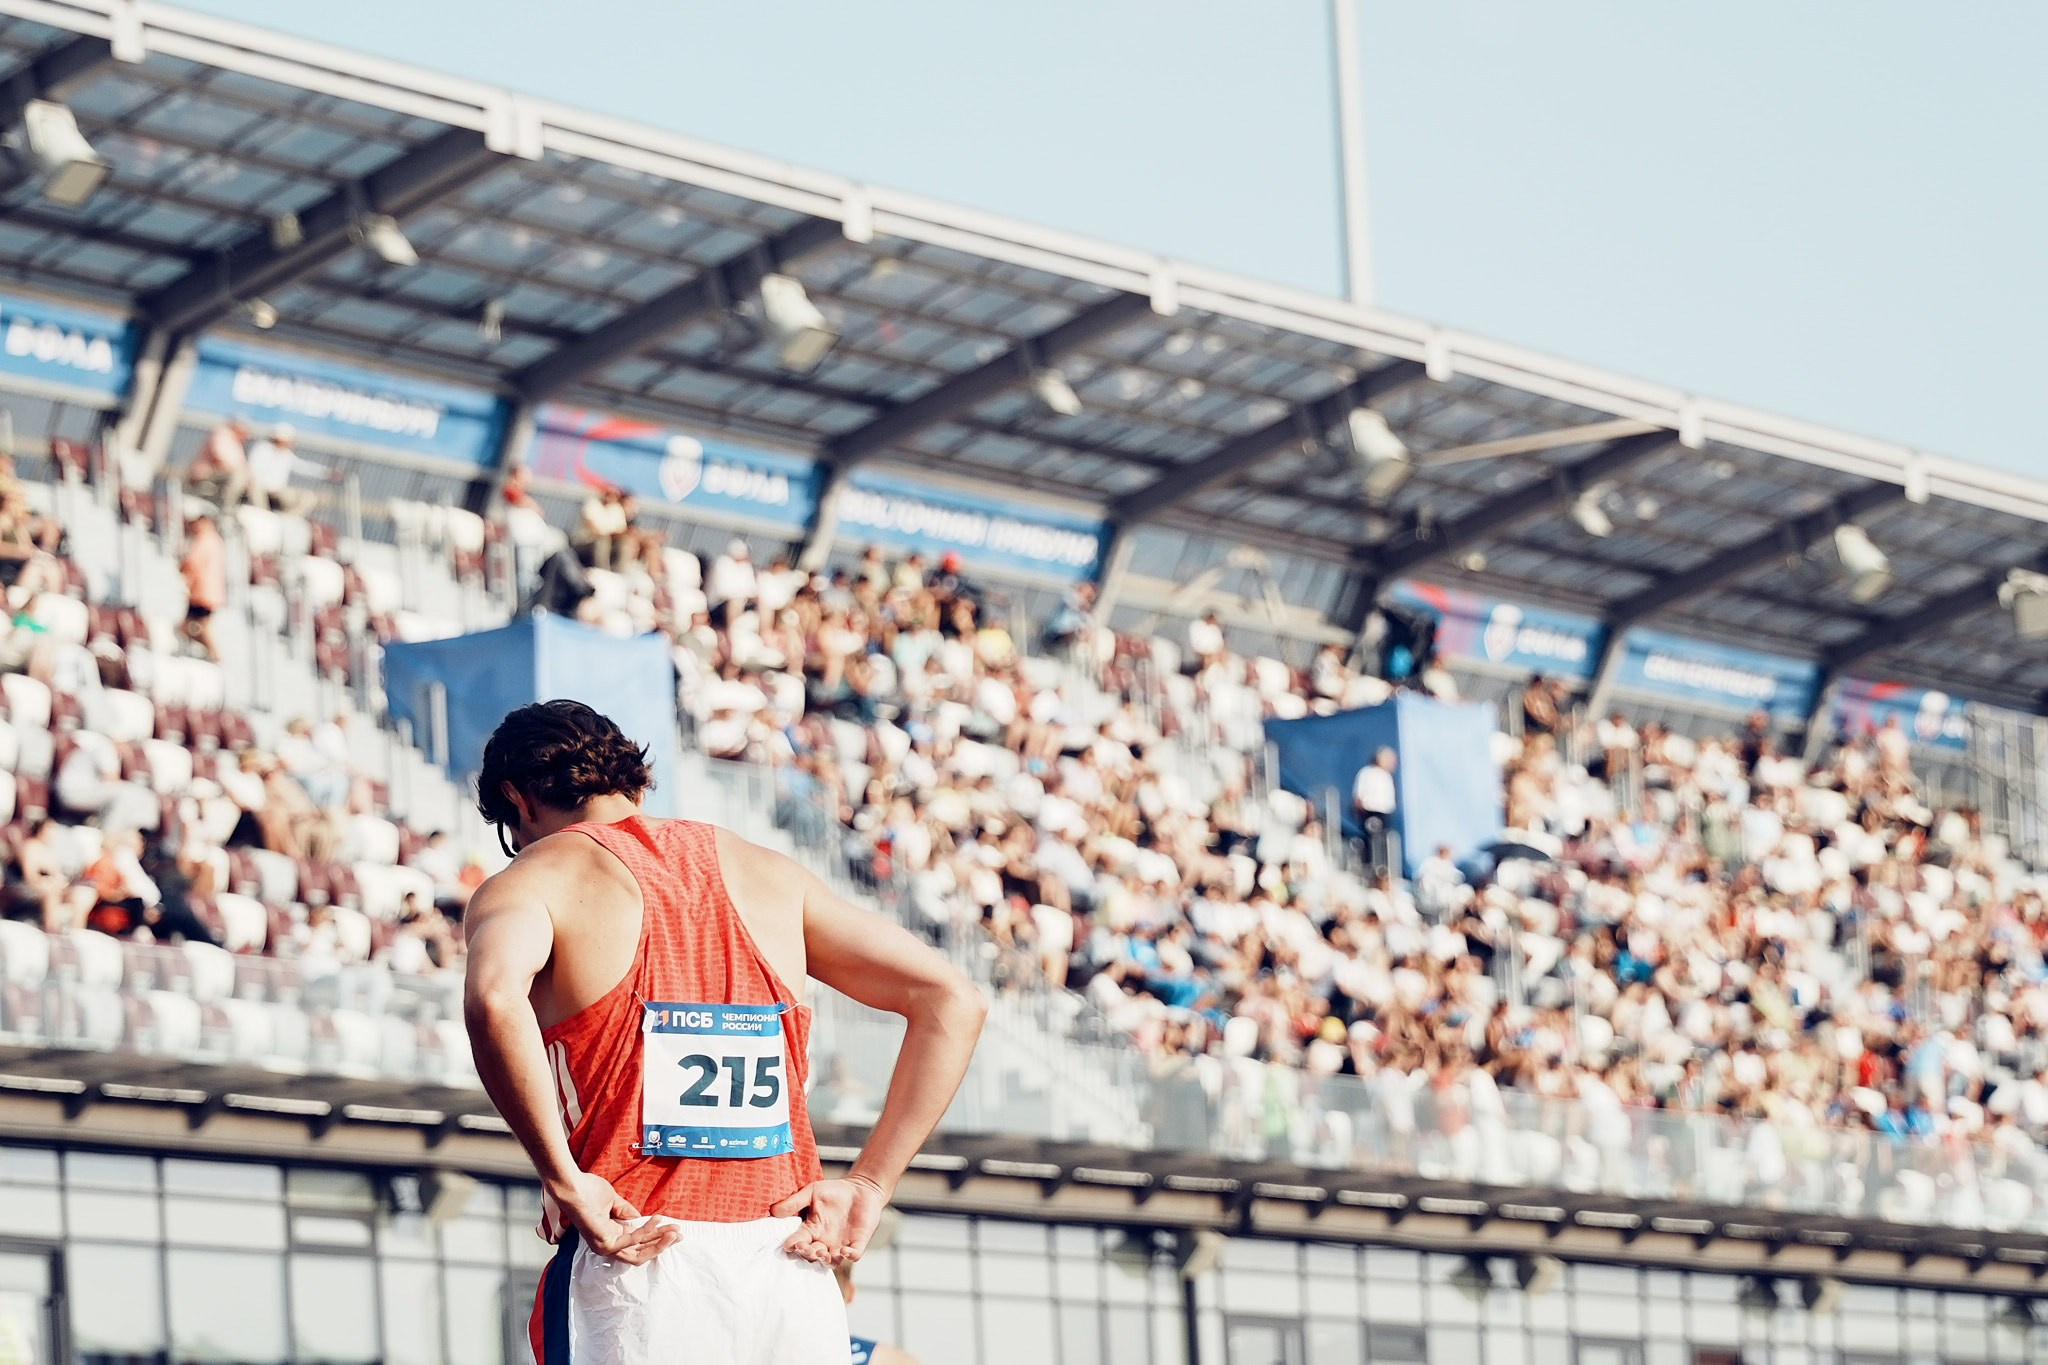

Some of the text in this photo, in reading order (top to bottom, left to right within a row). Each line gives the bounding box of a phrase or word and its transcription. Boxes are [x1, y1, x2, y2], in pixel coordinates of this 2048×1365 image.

[672, 1011, 713, 1028] ПСБ
[722, 1022, 762, 1031] РОССИИ
[677, 1054, 780, 1108] 215
